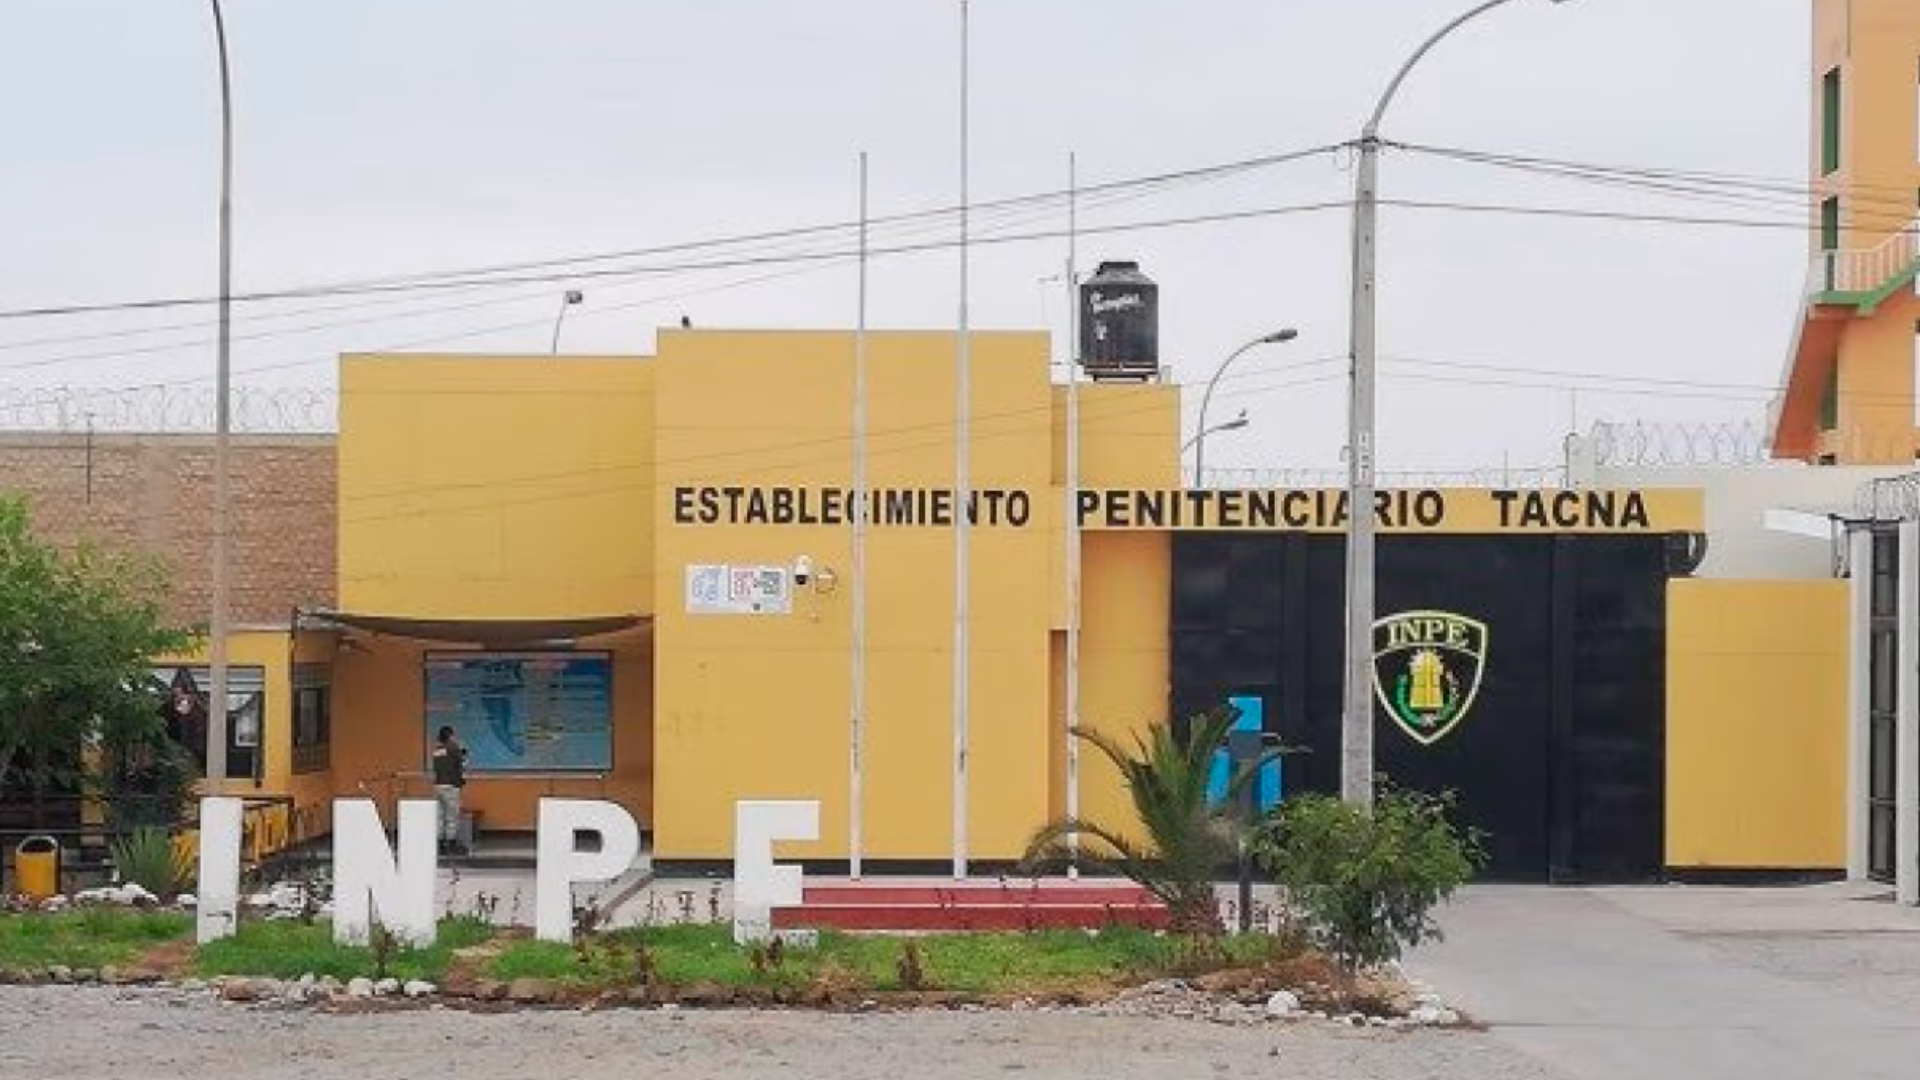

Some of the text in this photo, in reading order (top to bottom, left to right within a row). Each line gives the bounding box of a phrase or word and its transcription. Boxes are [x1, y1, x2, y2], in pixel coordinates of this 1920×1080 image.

[1077, 489, 1446, 528] PENITENCIARIO
[1491, 490, 1648, 527] TACNA
[1387, 619, 1469, 648] INPE
[196, 797, 821, 948] INPE
